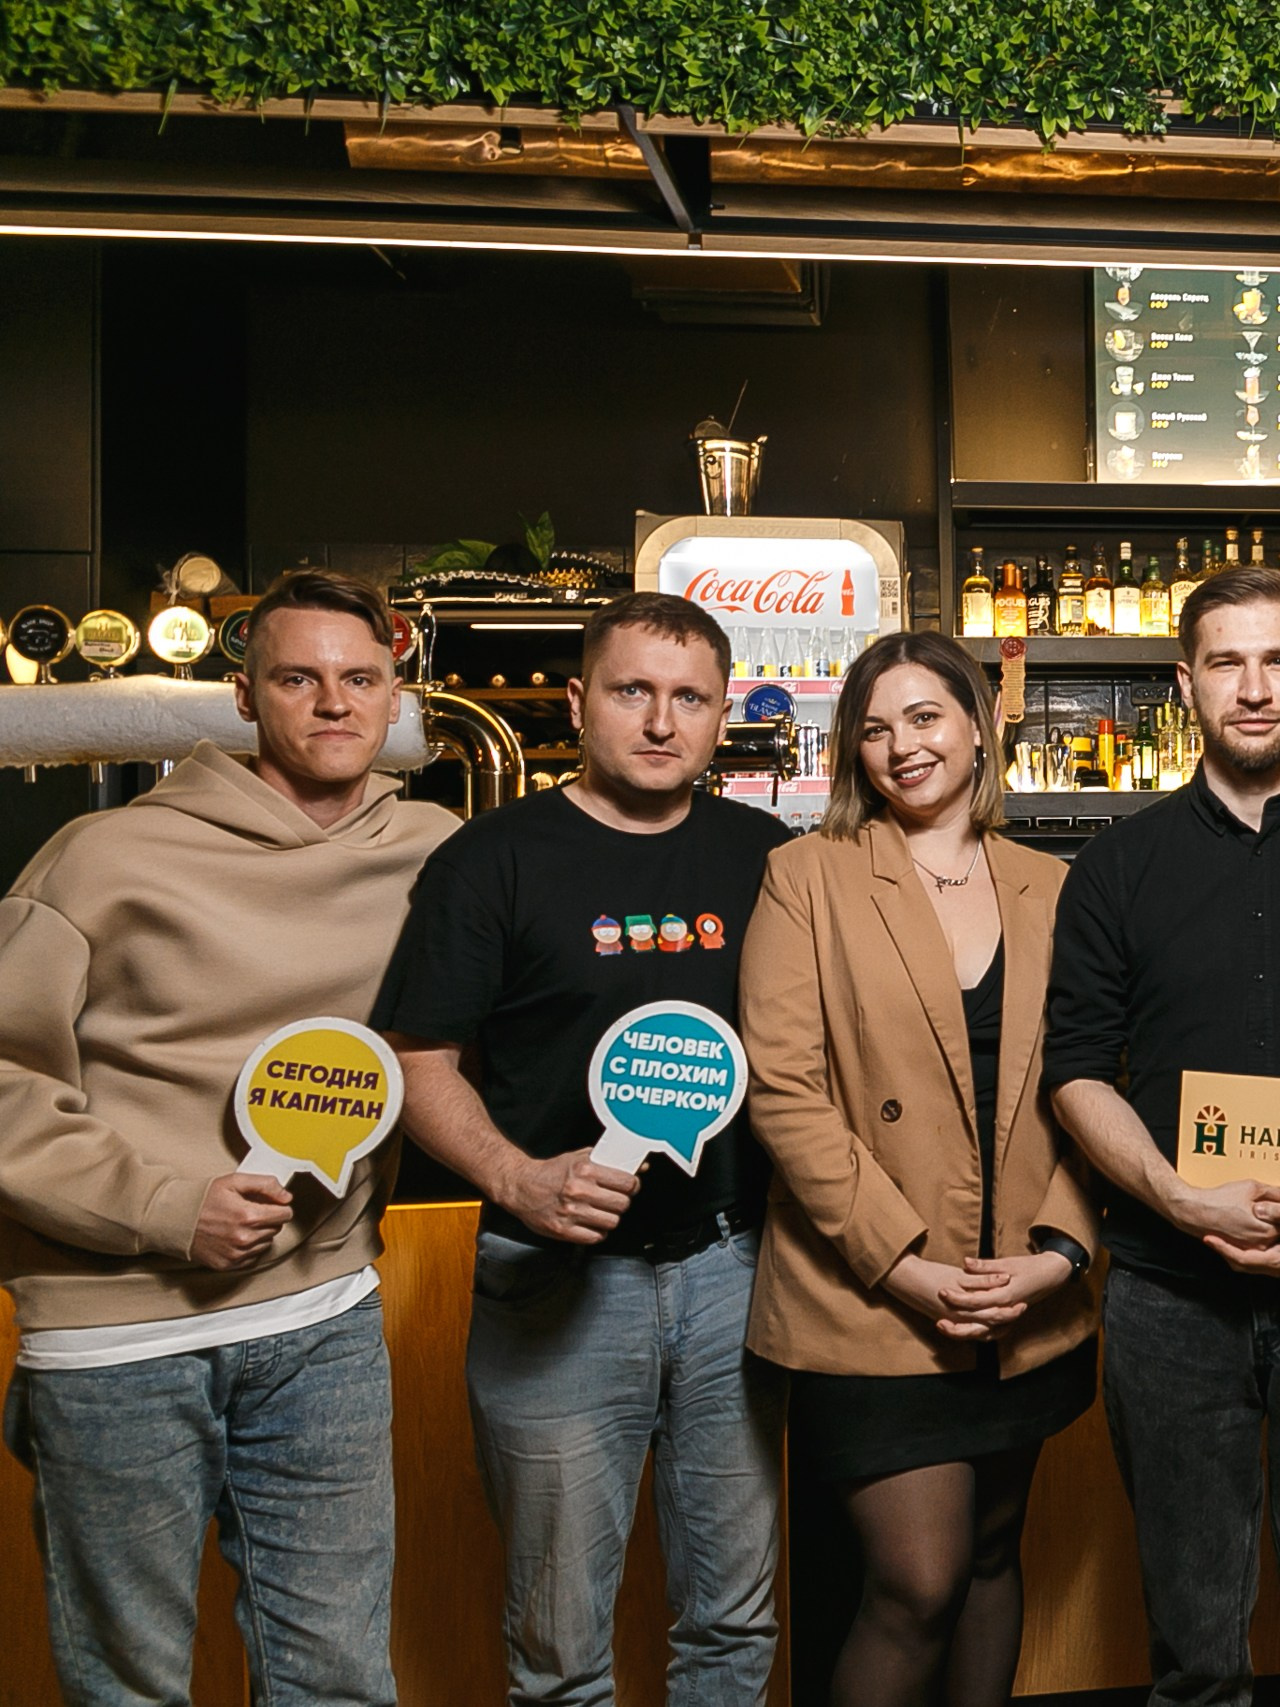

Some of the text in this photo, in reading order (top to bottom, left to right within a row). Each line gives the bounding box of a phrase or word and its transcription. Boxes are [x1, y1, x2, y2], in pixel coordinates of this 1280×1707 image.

[684, 567, 833, 615] Coca-Cola
[623, 1031, 725, 1060] ЧЕЛОВЕК
[266, 1060, 379, 1091] СЕГОДНЯ
[609, 1056, 728, 1087] С ПЛОХИМ
[248, 1087, 384, 1120] Я КАПИТАН
[602, 1082, 728, 1114] ПОЧЕРКОМ
